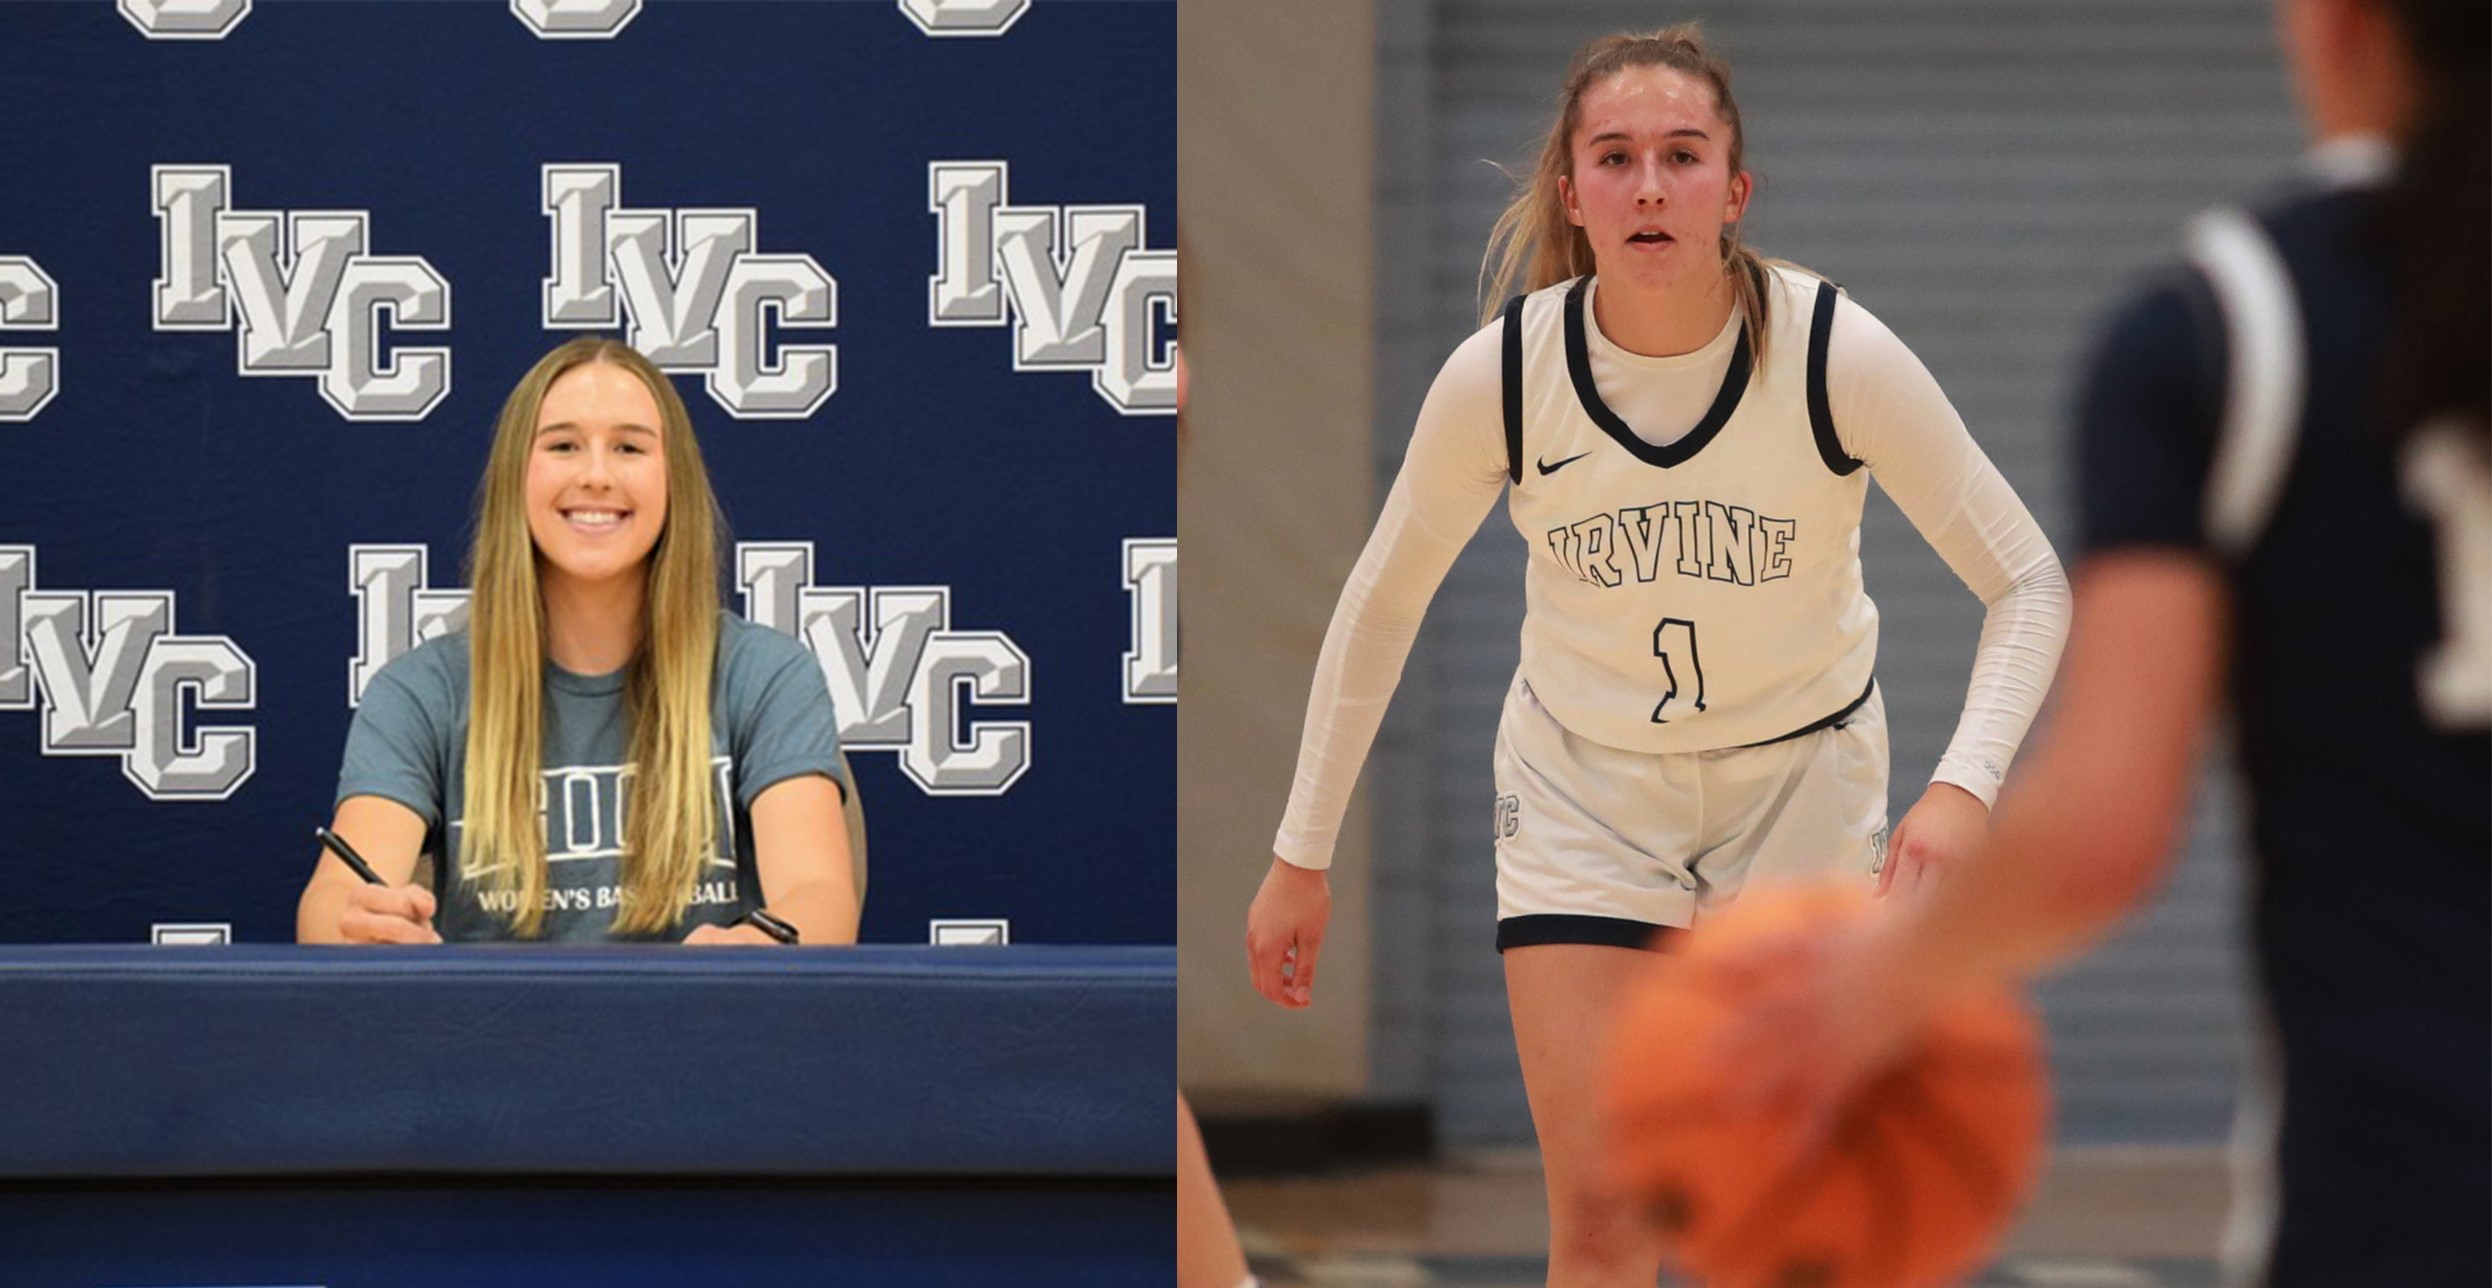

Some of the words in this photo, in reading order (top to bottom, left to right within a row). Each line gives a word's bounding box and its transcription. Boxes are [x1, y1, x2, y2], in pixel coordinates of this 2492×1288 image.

[151, 164, 451, 421] IVC
[542, 163, 837, 419] IVC
[929, 161, 1177, 415] IVC
[1547, 500, 1796, 588] IRVINE
[1650, 617, 1706, 724] 1
[477, 888, 591, 912] WOEN'S
